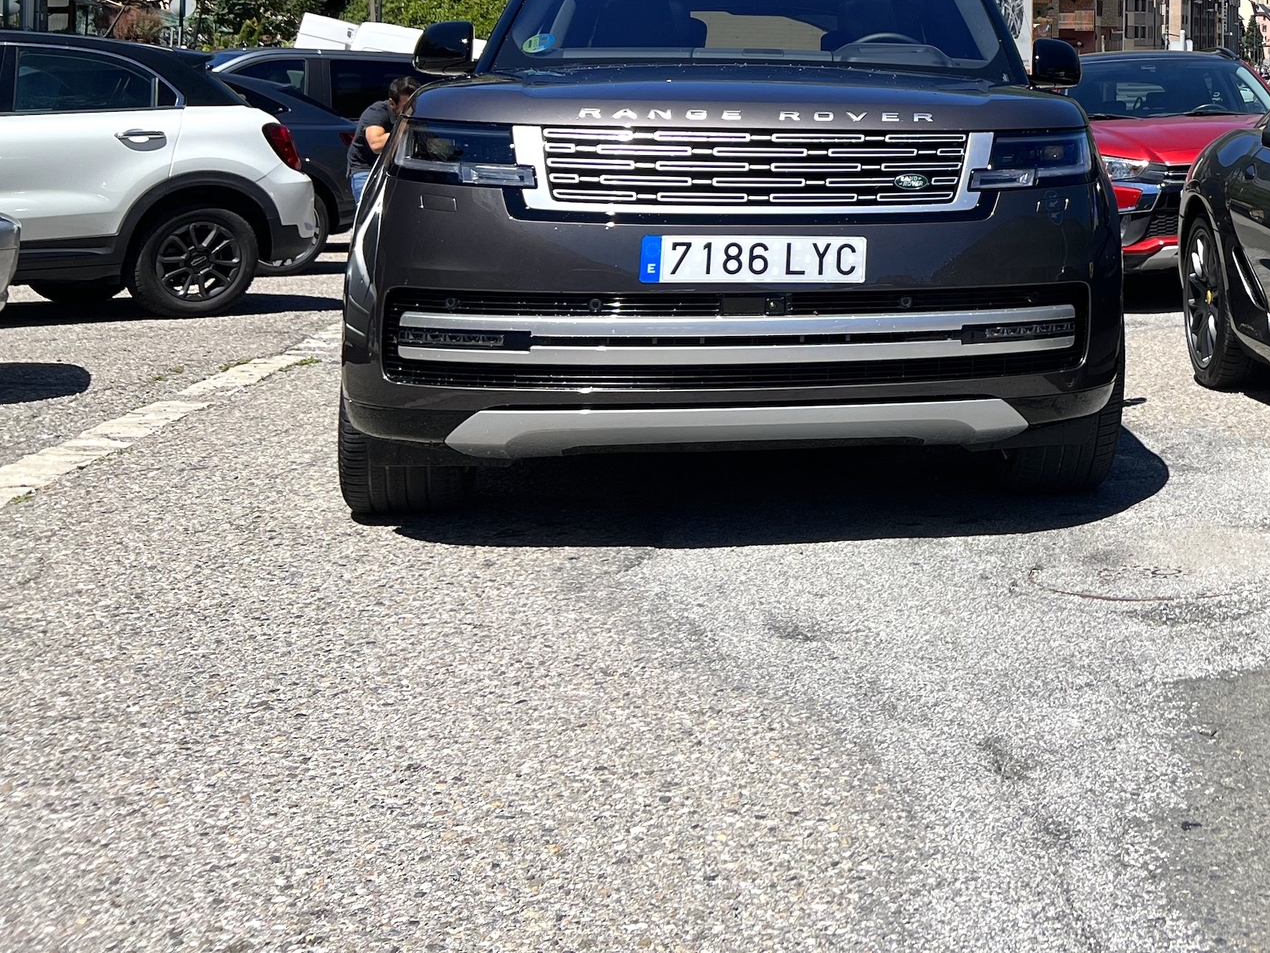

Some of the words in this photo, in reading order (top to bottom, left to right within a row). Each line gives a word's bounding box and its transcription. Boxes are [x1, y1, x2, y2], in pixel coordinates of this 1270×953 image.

[578, 108, 742, 120] RANGE
[779, 110, 934, 123] ROVER
[647, 264, 656, 273] E
[670, 242, 769, 275] 7186
[785, 242, 857, 276] LYC
